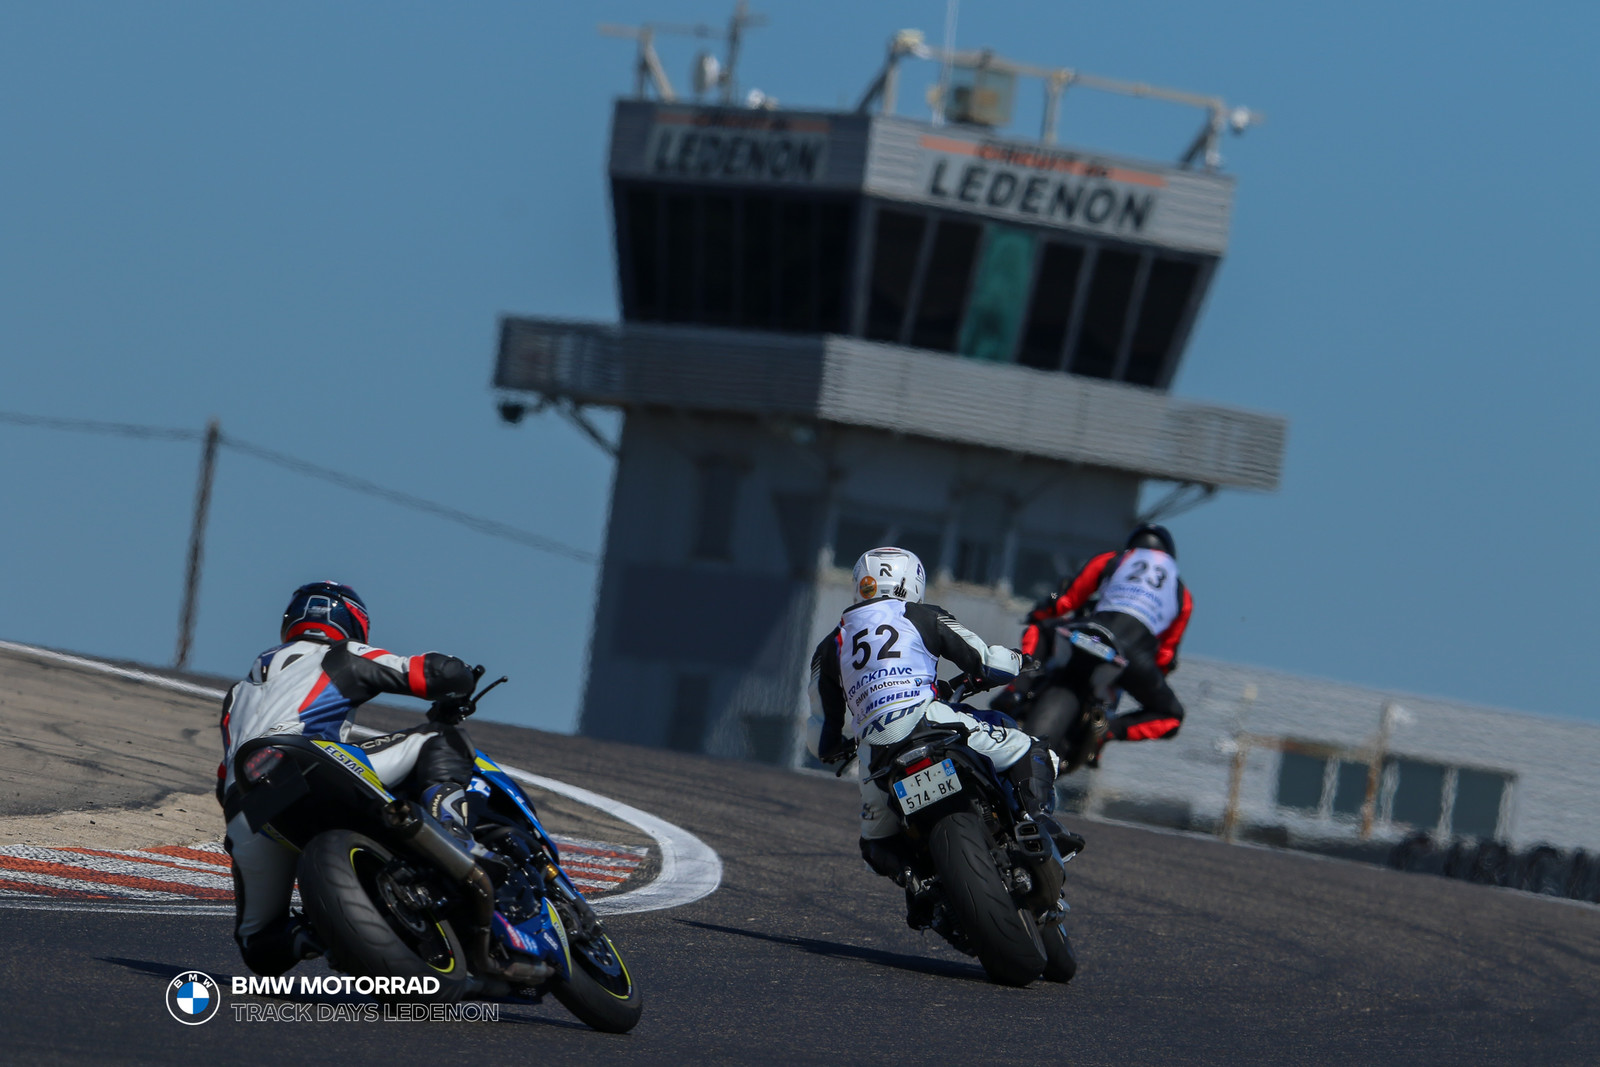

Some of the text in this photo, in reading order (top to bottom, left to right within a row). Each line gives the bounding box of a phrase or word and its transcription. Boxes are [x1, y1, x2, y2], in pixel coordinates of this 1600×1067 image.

[929, 156, 1156, 232] LEDENON
[1126, 560, 1168, 589] 23
[852, 624, 901, 671] 52
[869, 679, 911, 694] Motorrad
[865, 690, 921, 714] MICHELIN
[324, 744, 365, 775] ECSTAR
